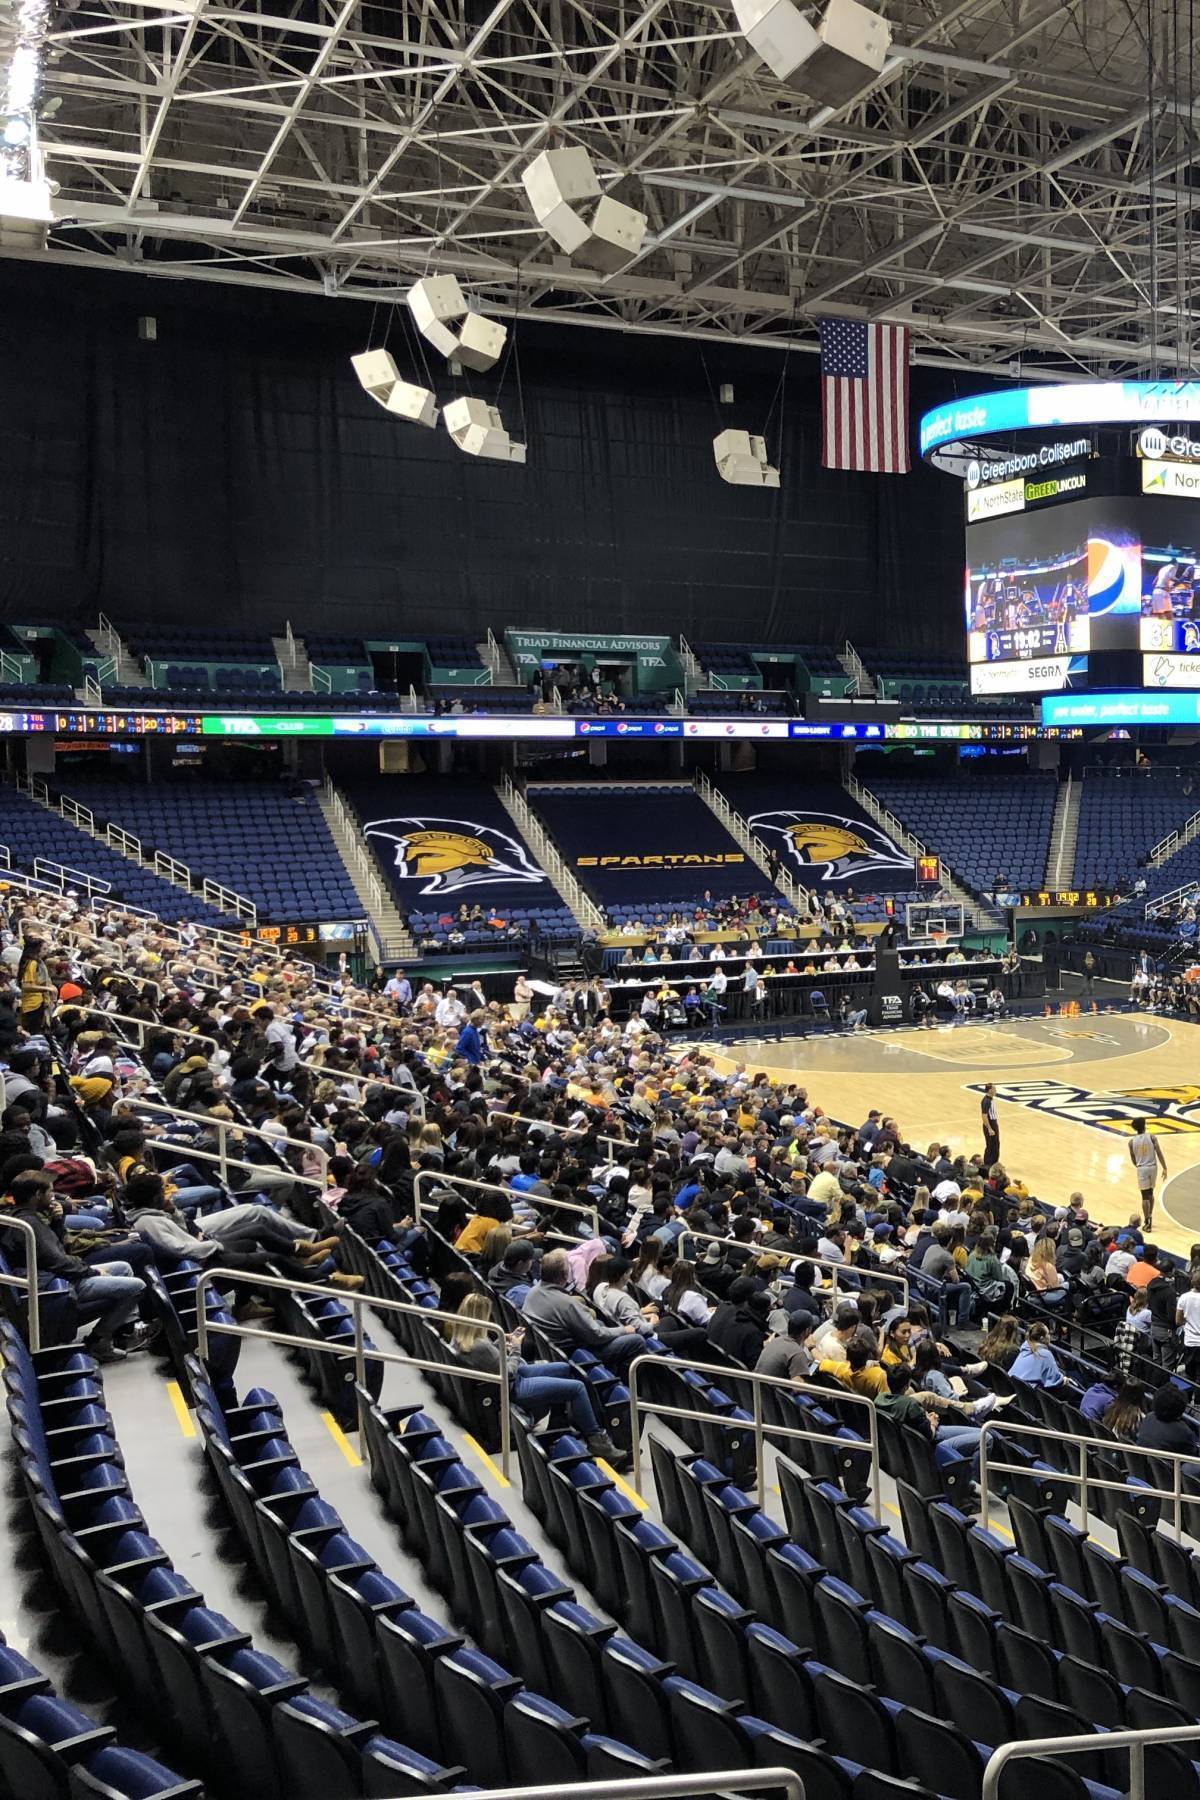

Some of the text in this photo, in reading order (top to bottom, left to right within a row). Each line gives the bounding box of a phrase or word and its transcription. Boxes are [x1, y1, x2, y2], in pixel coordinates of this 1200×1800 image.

[982, 439, 1088, 480] Greensboro Coliseum
[1025, 480, 1057, 500] GREEN
[984, 489, 1023, 508] NorthState
[1014, 630, 1041, 649] 19:02
[1152, 623, 1173, 647] 31
[516, 637, 660, 650] TRIAD FINANCIAL ADVISORS
[640, 657, 666, 666] TFA
[1028, 665, 1061, 679] SEGRA
[119, 719, 125, 728] 4
[145, 719, 157, 729] 20
[175, 721, 186, 730] 21
[905, 727, 961, 737] DO THE DEW
[577, 854, 744, 866] SPARTANS
[882, 995, 902, 1004] TFA
